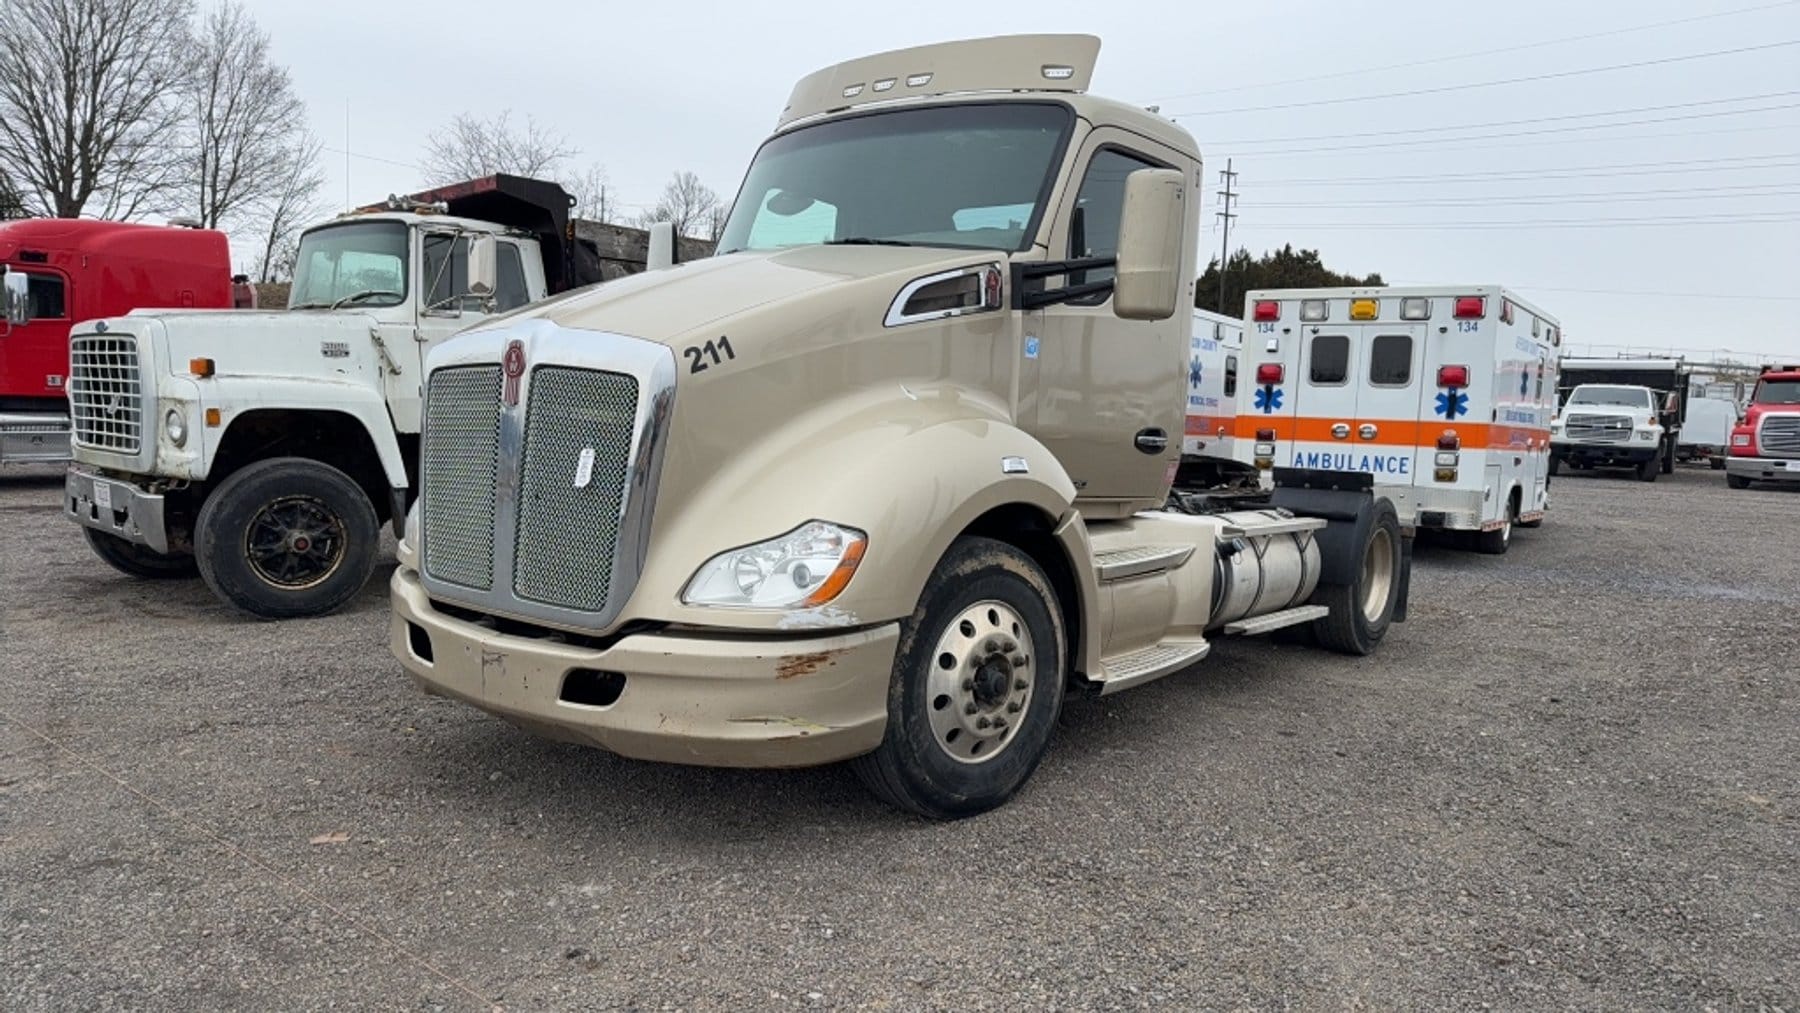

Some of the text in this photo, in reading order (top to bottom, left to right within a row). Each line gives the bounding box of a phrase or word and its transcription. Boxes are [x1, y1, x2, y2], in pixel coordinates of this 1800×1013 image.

[1257, 323, 1274, 333] 134
[1457, 322, 1478, 333] 134
[684, 335, 735, 374] 211
[1294, 453, 1410, 474] AMBULANCE
